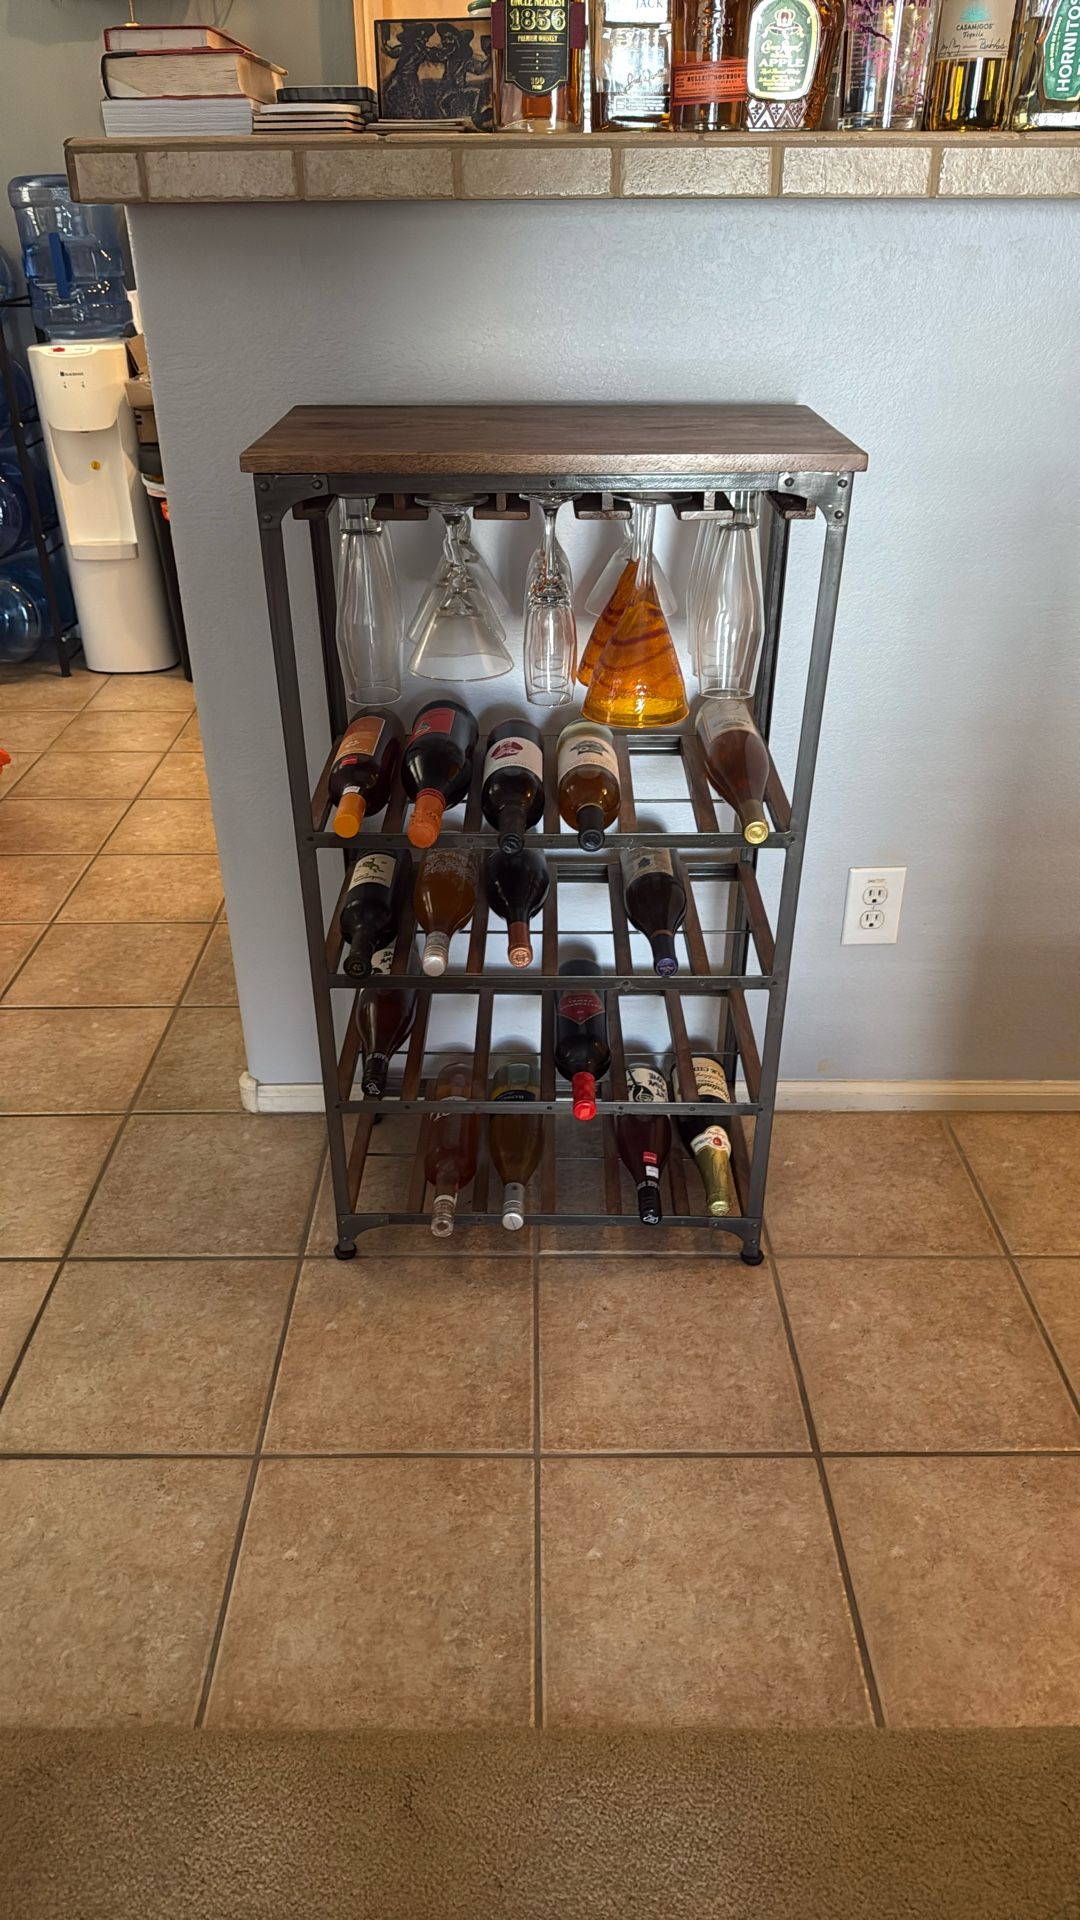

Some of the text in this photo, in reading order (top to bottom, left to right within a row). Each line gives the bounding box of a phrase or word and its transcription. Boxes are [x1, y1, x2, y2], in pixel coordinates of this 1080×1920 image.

[636, 0, 663, 9] JACK
[510, 8, 566, 31] 1856
[956, 23, 994, 31] CASAMIGOS
[758, 58, 805, 67] APPLE
